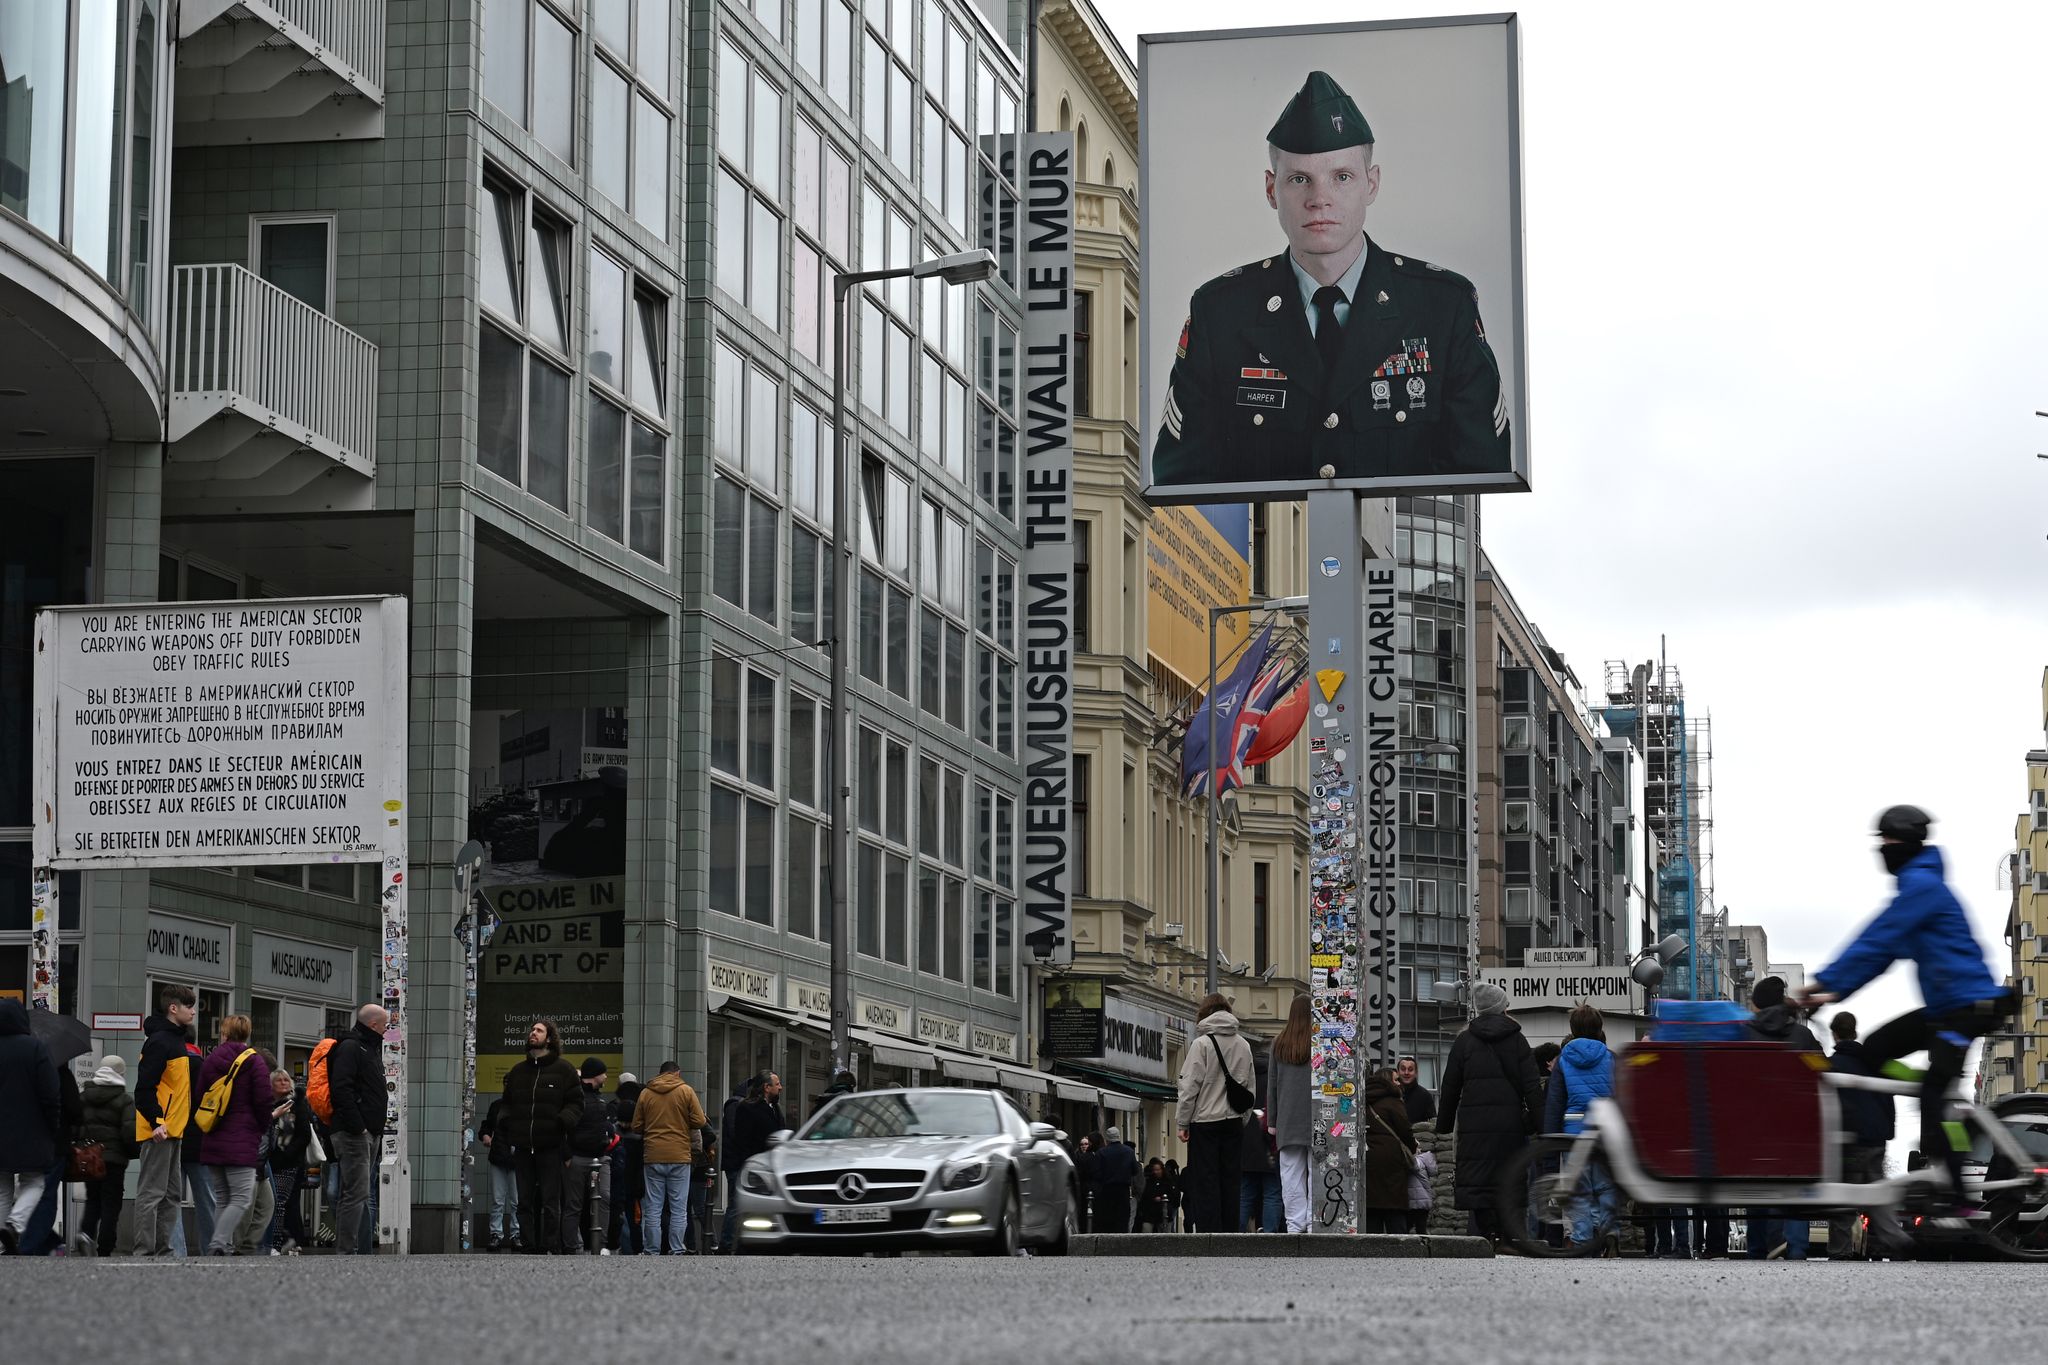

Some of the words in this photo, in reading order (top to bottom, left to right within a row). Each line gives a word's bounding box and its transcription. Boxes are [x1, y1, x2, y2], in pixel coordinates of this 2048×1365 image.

[1029, 148, 1070, 252] MUR
[1028, 267, 1068, 311] LE
[1027, 334, 1068, 457] WALL
[1247, 392, 1275, 403] HARPER
[1026, 470, 1067, 549] THE
[81, 616, 108, 633] YOU
[114, 615, 138, 632] ARE
[145, 613, 205, 631] ENTERING
[212, 611, 233, 629] THE
[239, 609, 306, 628] AMERICAN
[312, 607, 362, 626] SECTOR
[80, 635, 146, 653] CARRYING
[151, 633, 214, 651] WEAPONS
[220, 632, 243, 649] OFF
[251, 630, 283, 648] DUTY
[289, 627, 361, 646] FORBIDDEN
[1368, 569, 1396, 701] CHARLIE
[152, 655, 187, 671] OBEY
[193, 653, 244, 670] TRAFFIC
[251, 651, 290, 669] RULES
[87, 688, 107, 705] ВЫ
[199, 680, 302, 702] АМЕРИКАНСКИЙ
[308, 680, 355, 698] СЕКТОР
[75, 709, 116, 726] НОСИТЬ
[119, 707, 163, 724] ОРУЖИЕ
[246, 702, 325, 720] НЕСЛУЖЕБНОЕ
[328, 700, 365, 718] ВРЕМЯ
[187, 724, 263, 742] ДОРОЖНЫМ
[271, 722, 343, 740] ПРАВИЛАМ
[75, 760, 109, 777] VOUS
[116, 759, 161, 776] ENTREZ
[169, 757, 202, 774] DANS
[209, 757, 220, 772] LE
[227, 755, 283, 772] SECTEUR
[1025, 573, 1068, 947] MAUERMUSEUM
[74, 780, 118, 796] DEFENSE
[121, 779, 135, 795] DE
[136, 778, 175, 794] PORTER
[177, 777, 198, 793] DES
[200, 776, 234, 793] ARMES
[238, 776, 252, 791] EN
[256, 774, 298, 791] DEHORS
[302, 773, 317, 790] DU
[320, 772, 365, 789] SERVICE
[89, 798, 151, 816] OBEISSEZ
[158, 798, 184, 814] AUX
[190, 796, 236, 813] REGLES
[243, 796, 258, 811] DE
[265, 793, 347, 811] CIRCULATION
[1369, 711, 1396, 919] CHECKPOINT
[74, 832, 94, 850] SIE
[100, 831, 160, 850] BETRETEN
[166, 830, 190, 848] DEN
[195, 827, 306, 848] AMERIKANISCHEN
[312, 825, 361, 845] SEKTOR
[342, 843, 353, 851] US
[355, 843, 377, 851] ARMY
[498, 886, 576, 913] COME
[590, 881, 614, 906] IN
[502, 923, 552, 944] AND
[564, 922, 592, 942] BE
[182, 934, 220, 965] CHARLIE
[1369, 929, 1396, 983] AM
[1533, 951, 1552, 963] ALLIED
[1553, 951, 1588, 963] CHECKPOINT
[271, 951, 332, 984] MUSEUMSSHOP
[495, 953, 563, 975] PART
[577, 951, 609, 974] OF
[711, 965, 745, 993] CHECKPOINT
[746, 973, 768, 999] CHARLIE
[1513, 977, 1550, 997] ARMY
[1556, 976, 1633, 997] CHECKPOINT
[799, 987, 812, 1010] WALL
[504, 1013, 531, 1022] Unser
[532, 1013, 571, 1022] Museum
[572, 1013, 582, 1021] ist
[596, 1012, 618, 1021] allen
[504, 1025, 520, 1034] des
[559, 1024, 591, 1033] eöffnet.
[865, 1005, 898, 1028] MAUERMUSEUM
[504, 1038, 526, 1046] Hom
[587, 1037, 611, 1045] since
[919, 1017, 943, 1040] CHECKPOINT
[944, 1023, 960, 1043] CHARLIE
[974, 1031, 996, 1051] CHECKPOINT
[996, 1036, 1011, 1055] CHARLIE
[1134, 1025, 1163, 1062] CHARLIE
